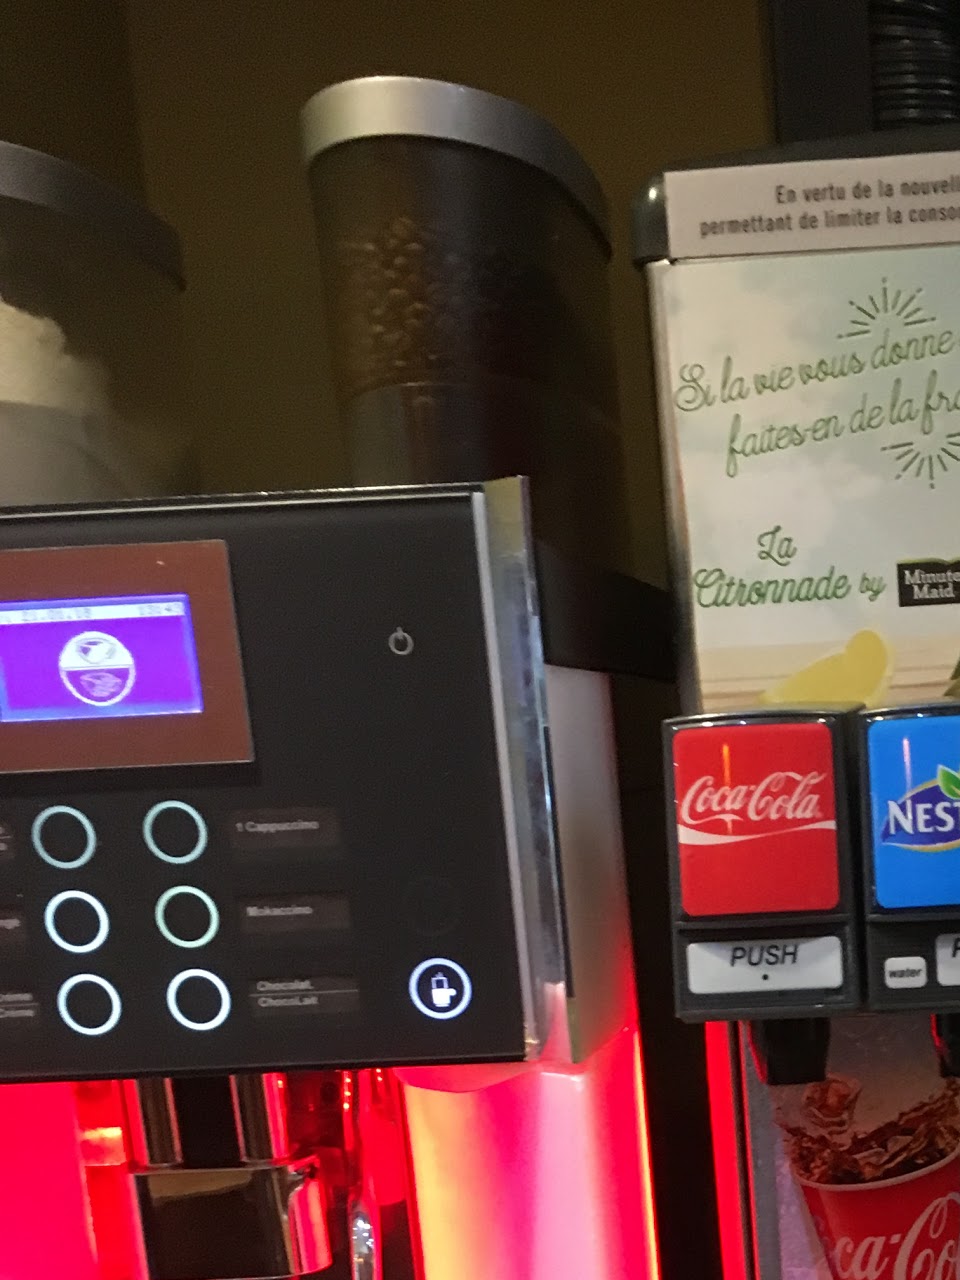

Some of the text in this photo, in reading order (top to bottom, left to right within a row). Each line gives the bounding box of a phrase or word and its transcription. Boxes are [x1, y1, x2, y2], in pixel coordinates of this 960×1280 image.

[776, 184, 797, 204] En
[802, 183, 846, 202] vertu
[852, 181, 872, 199] de
[877, 179, 894, 198] la
[700, 213, 793, 239] permettant
[799, 211, 819, 230] de
[824, 208, 880, 228] limiter
[886, 206, 903, 224] la
[675, 363, 716, 412] Si
[721, 356, 749, 402] la
[754, 363, 794, 395] vie
[799, 353, 865, 385] vous
[871, 328, 954, 370] donne
[850, 403, 886, 436] de
[889, 378, 920, 425] la
[757, 525, 798, 567] La
[693, 565, 887, 608] Citronnade by
[912, 585, 956, 600] Maid
[680, 771, 827, 825] Coca-Cola
[730, 943, 798, 968] PUSH
[889, 966, 922, 979] water
